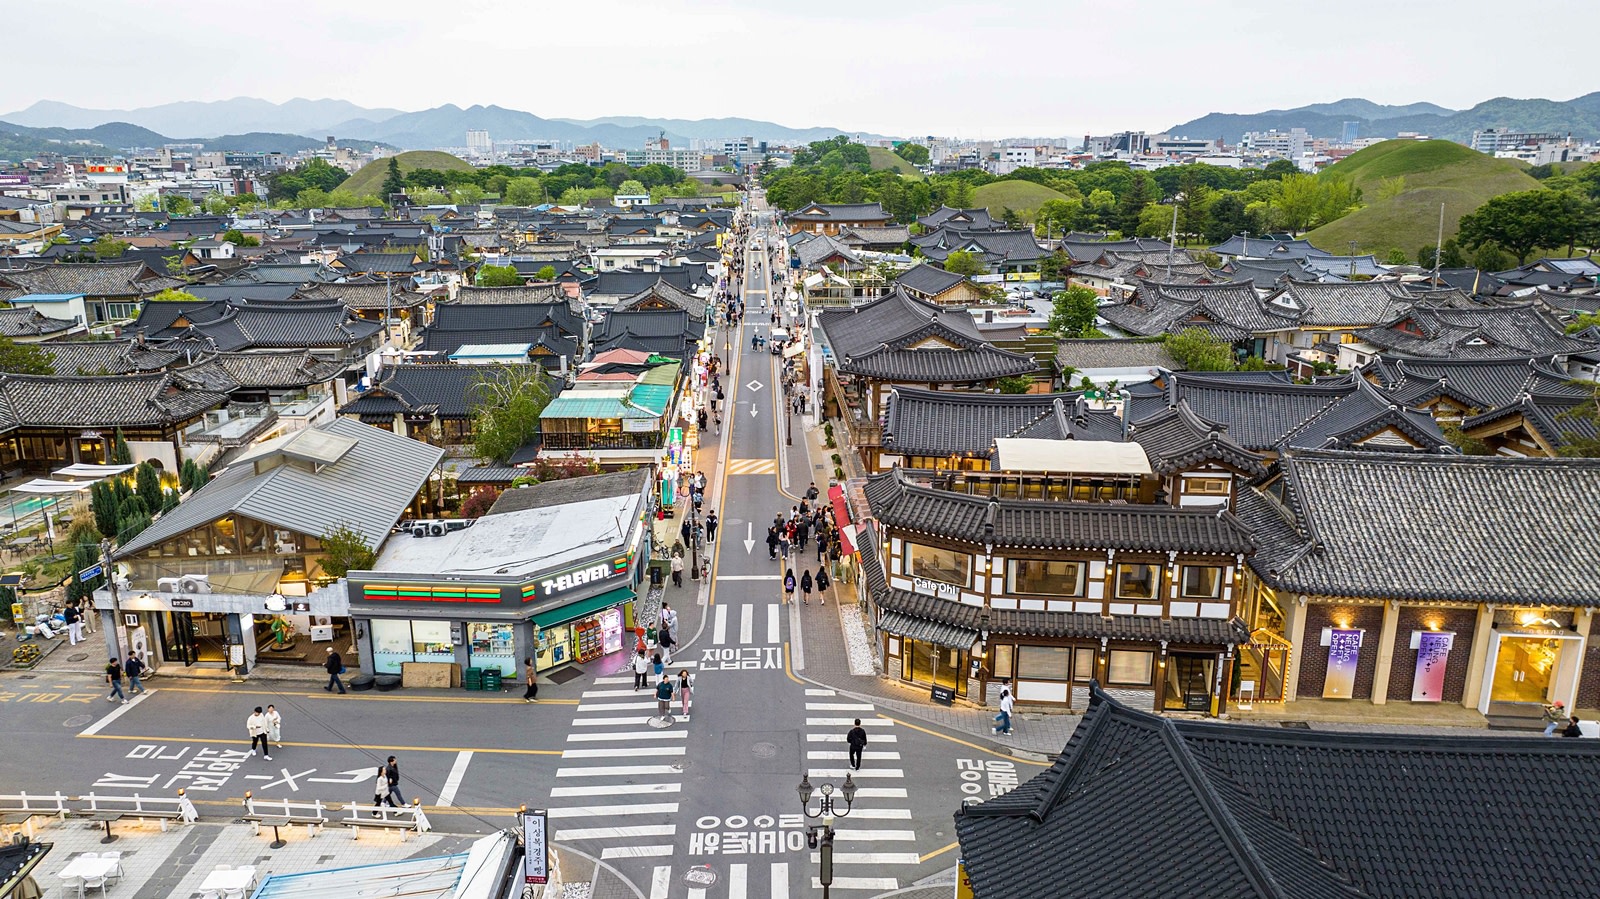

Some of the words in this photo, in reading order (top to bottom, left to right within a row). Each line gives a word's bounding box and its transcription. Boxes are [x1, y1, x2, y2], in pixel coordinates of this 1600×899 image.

[541, 563, 609, 595] 7-ELEVEN
[914, 577, 937, 591] Cafe
[1331, 633, 1339, 656] OPEN
[1343, 633, 1352, 662] NEUNG
[1350, 634, 1359, 655] CAFE
[1419, 637, 1428, 659] OPEN
[1432, 637, 1441, 664] NEUNG
[1439, 637, 1449, 657] CAFE
[699, 647, 783, 671] 진입금지
[162, 746, 254, 791] 좌회전
